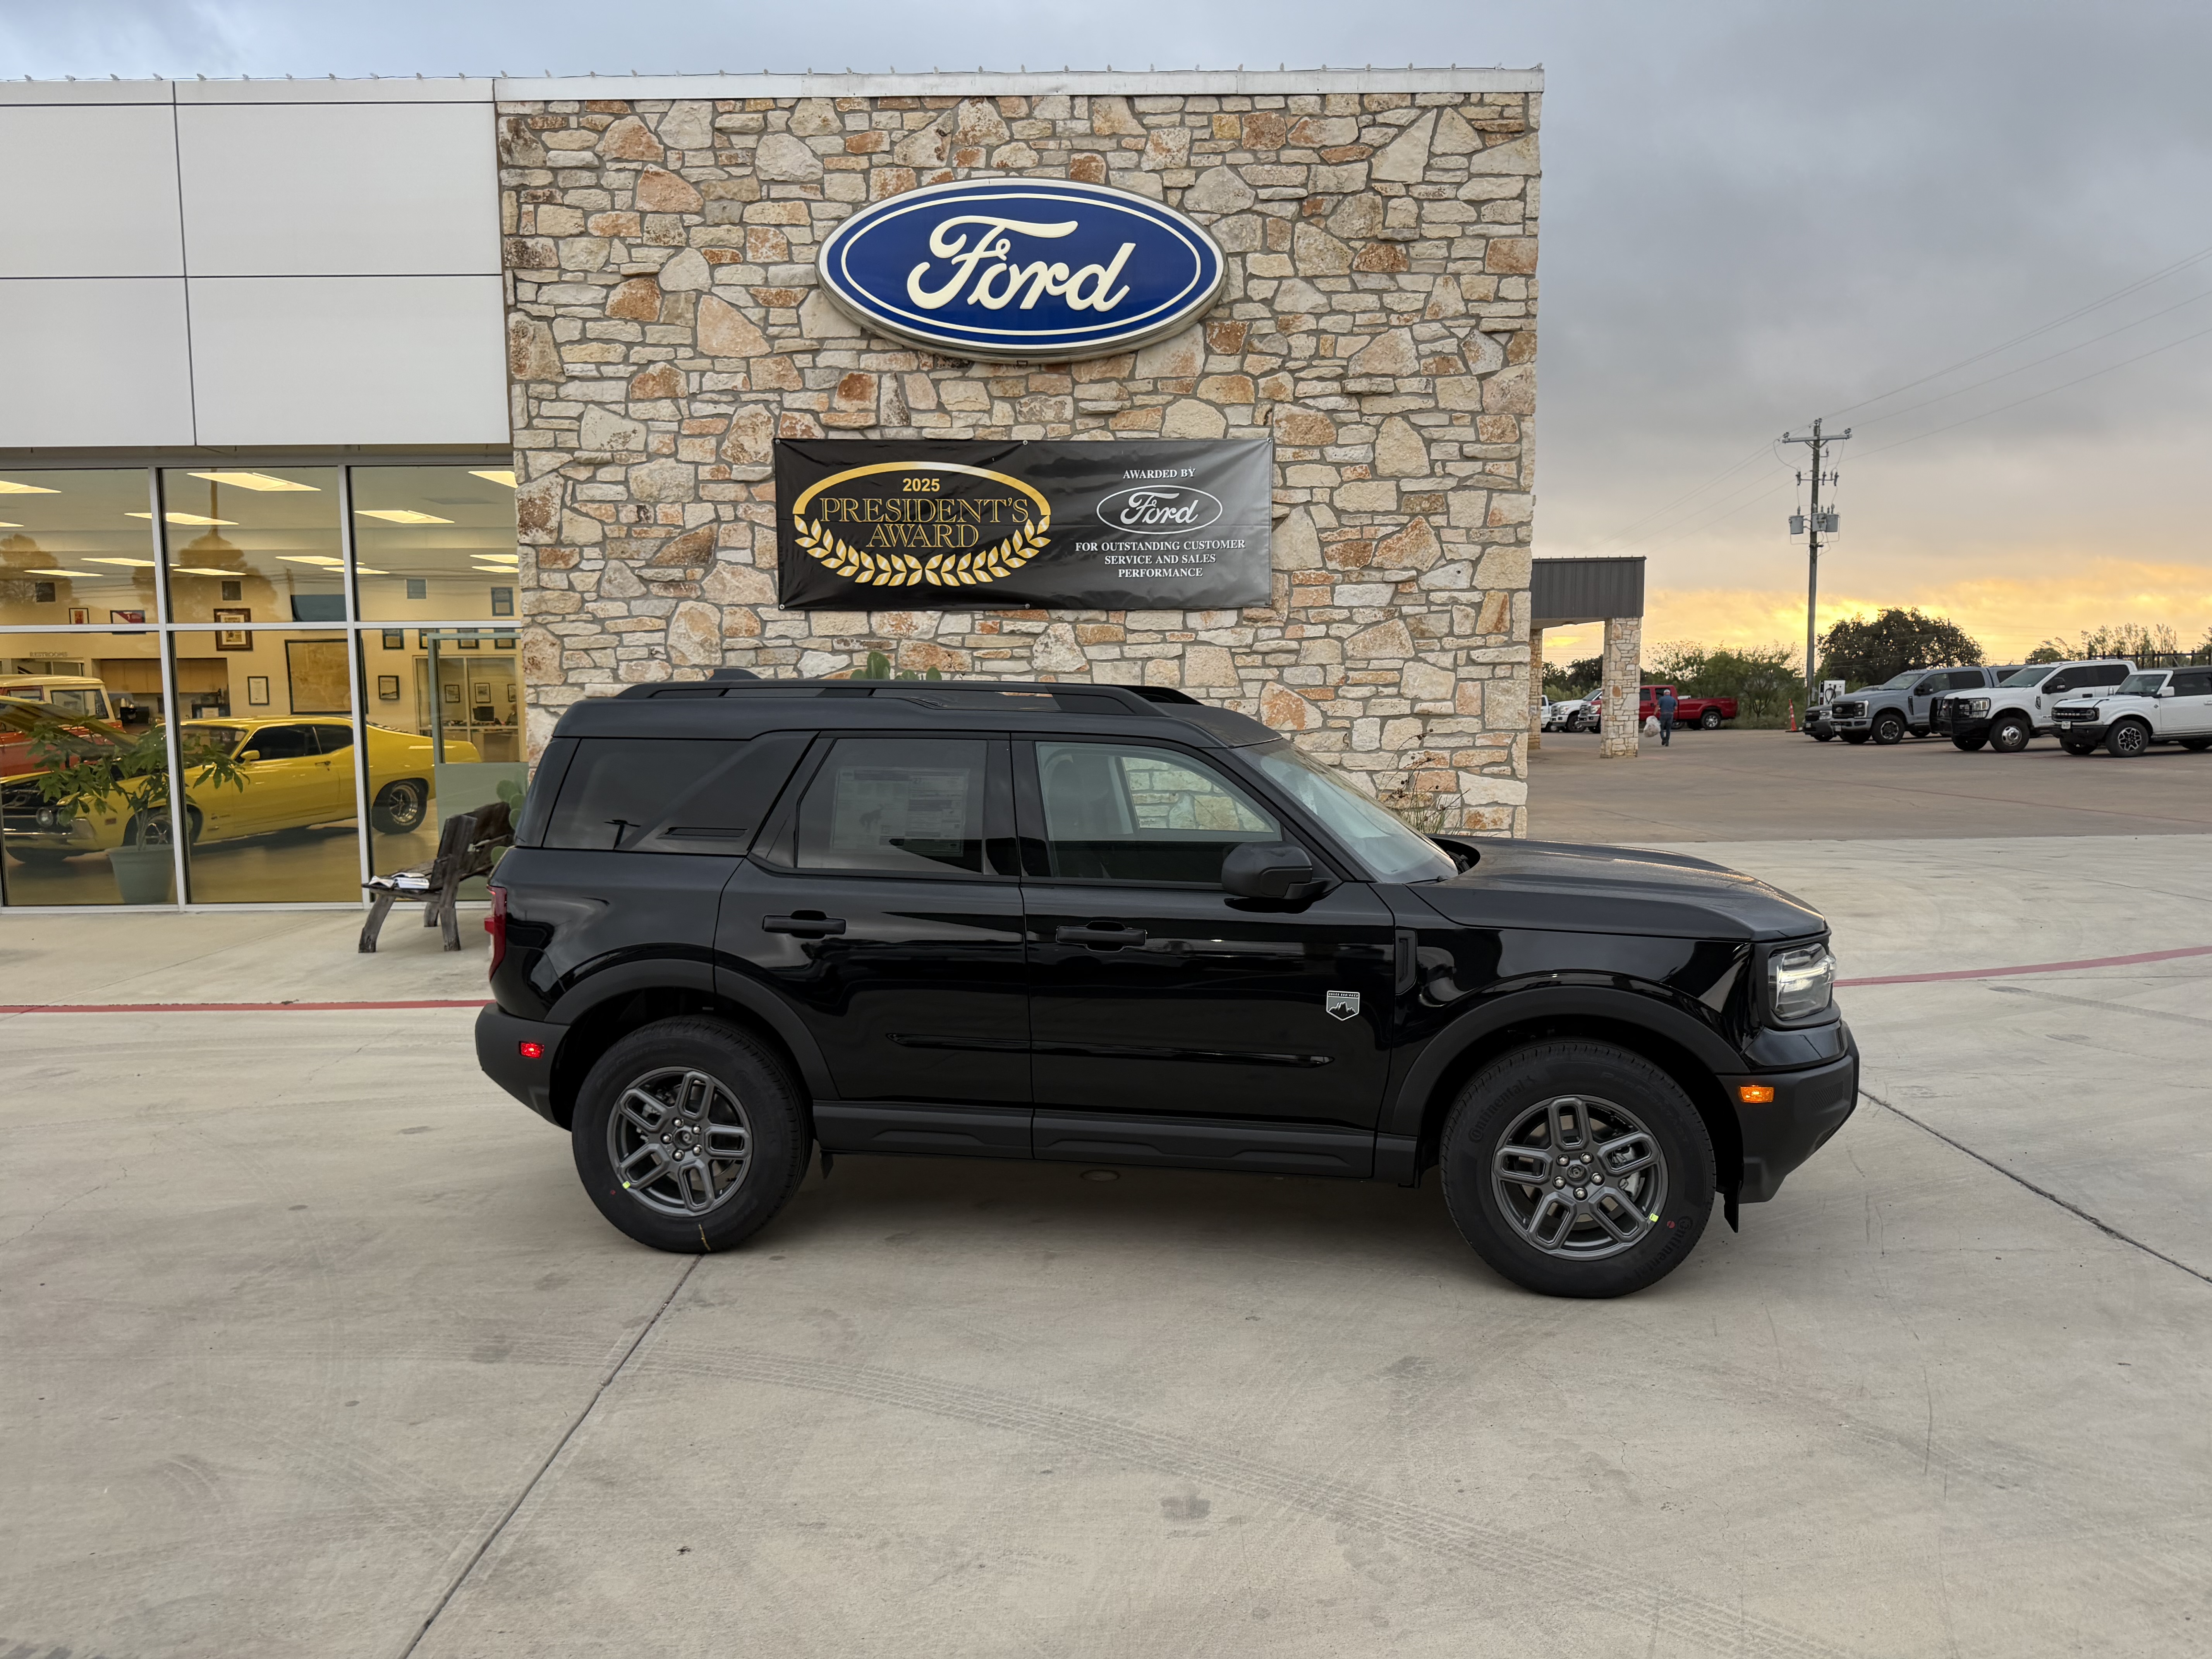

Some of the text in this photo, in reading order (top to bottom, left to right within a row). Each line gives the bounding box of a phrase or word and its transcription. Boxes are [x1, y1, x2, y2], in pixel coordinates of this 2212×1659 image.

[907, 215, 1135, 311] Ford
[1123, 468, 1196, 479] AWARDED BY
[903, 478, 940, 492] 2025
[819, 498, 1029, 523] PRESIDENT'S
[1120, 492, 1199, 525] Ford
[866, 523, 979, 548] AWARD
[1075, 539, 1246, 551] FOR OUTSTANDING CUSTOMER
[1104, 554, 1216, 565] SERVICE AND SALES
[1118, 568, 1203, 578] PERFORMANCE
